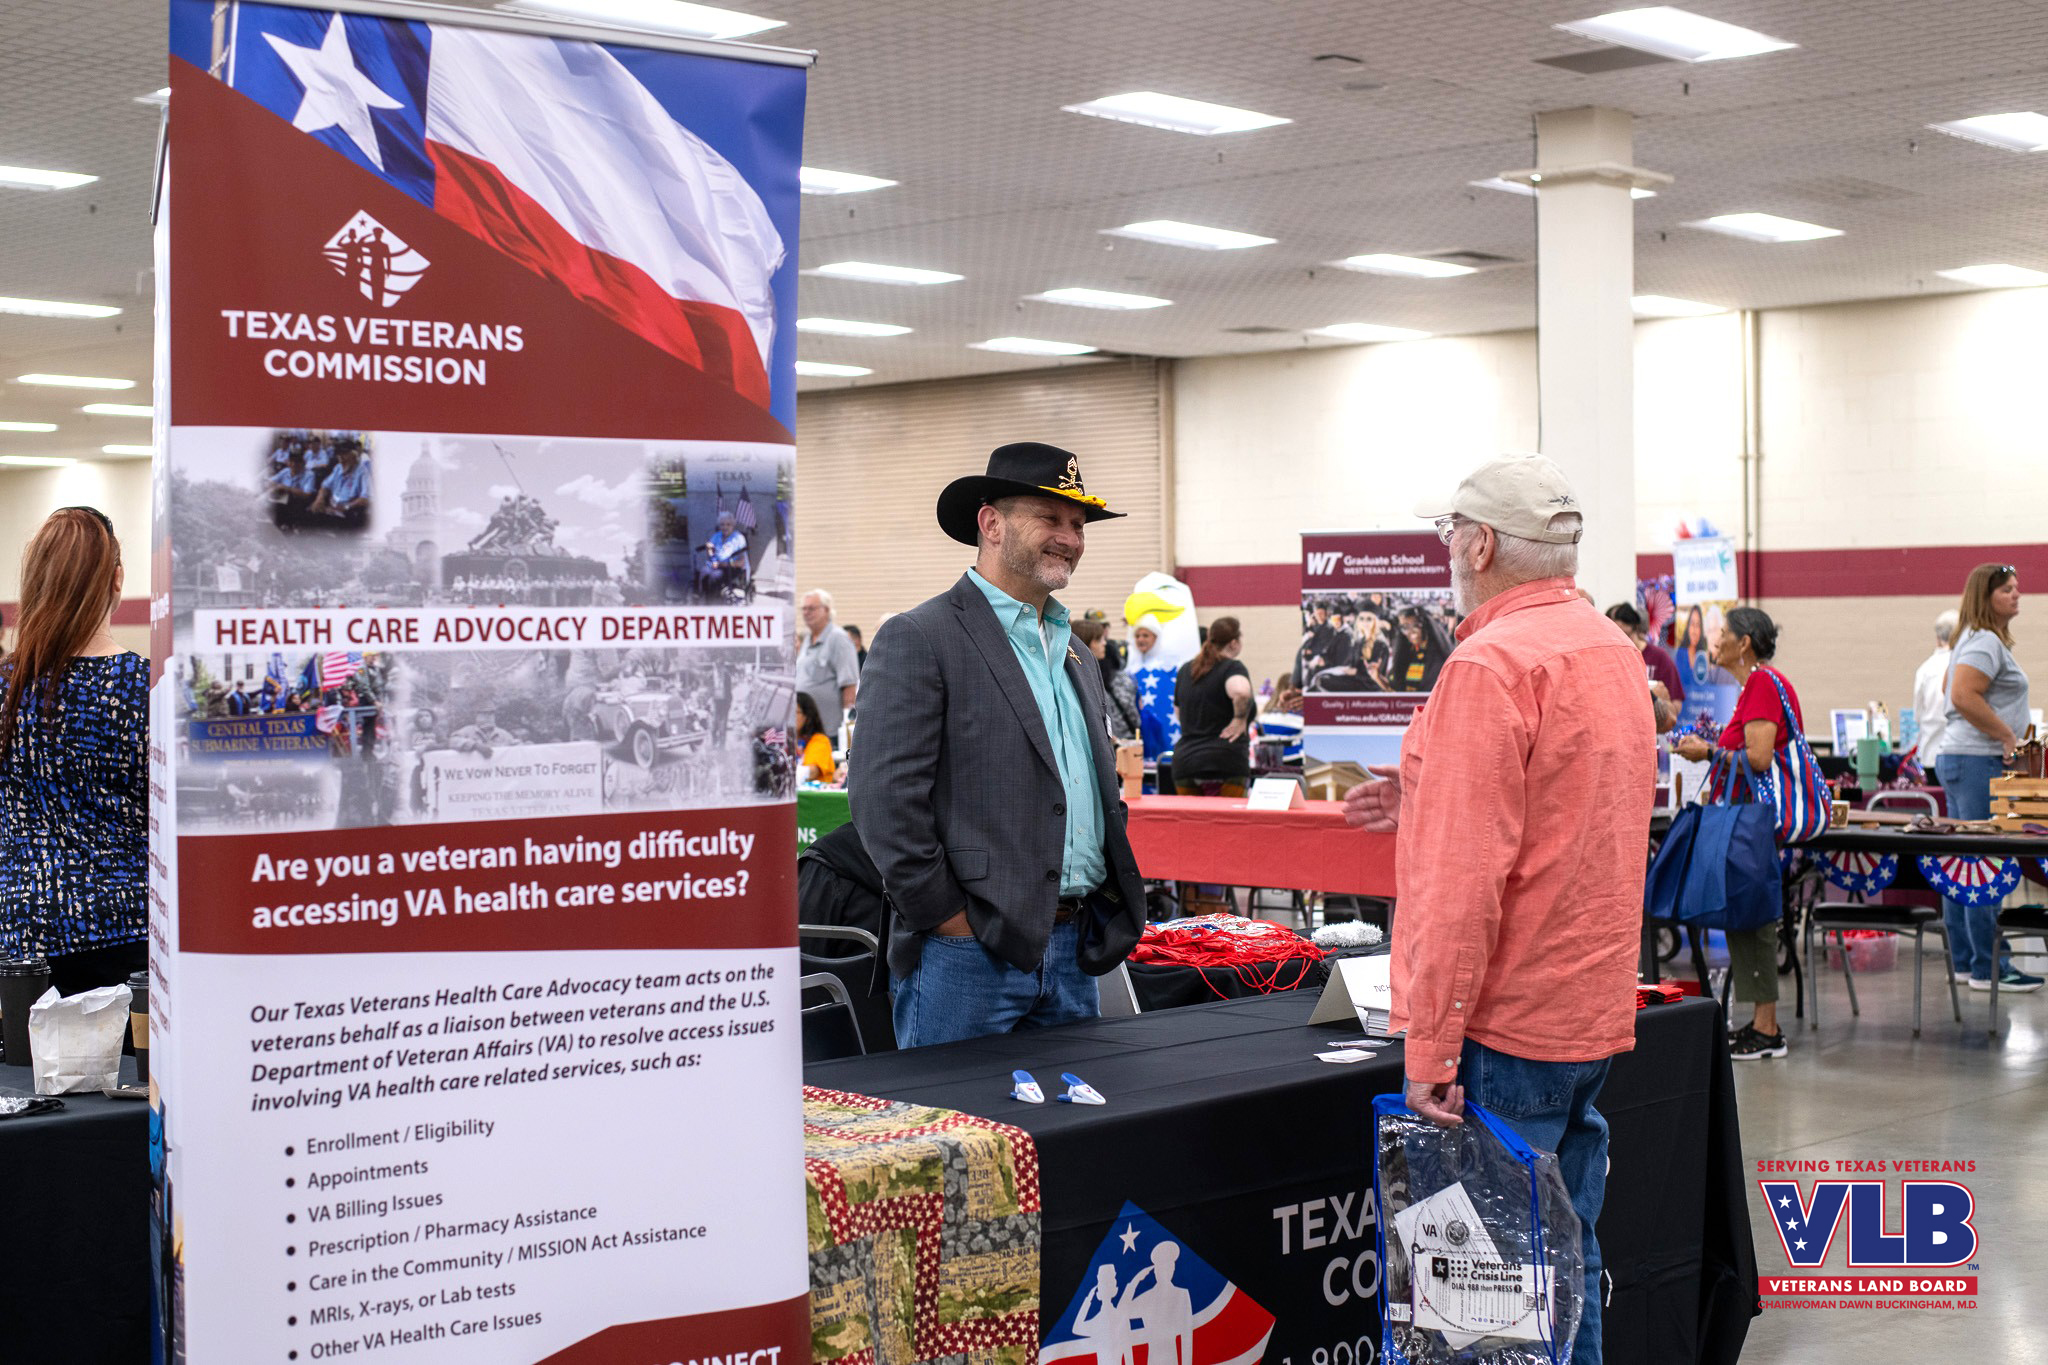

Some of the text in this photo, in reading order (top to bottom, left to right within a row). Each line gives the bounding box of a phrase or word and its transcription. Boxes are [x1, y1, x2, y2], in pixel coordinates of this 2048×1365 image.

[220, 309, 524, 352] TEXAS VETERANS
[263, 348, 486, 386] COMMISSION
[715, 470, 752, 482] TEXAS
[1307, 552, 1424, 575] WT Graduate School
[216, 615, 775, 646] HEALTH CARE ADVOCACY DEPARTMENT
[208, 719, 305, 737] CENTRAL TEXAS
[263, 735, 326, 750] VETERANS
[444, 763, 597, 780] WE VOW NEVER TO FORGET
[251, 828, 755, 887] Are you a veteran having difficulty
[251, 869, 750, 929] accessing VA health care services?
[250, 963, 775, 1024] Our Texas Veterans Health Care Advocacy team acts on the
[250, 989, 770, 1053] veterans behalf as a liaison between veterans and the U.S.
[250, 1019, 775, 1085] Department of Veteran Affairs (VA) to resolve access issues
[251, 1051, 702, 1112] involving VA health care related services, such as:
[306, 1118, 495, 1155] Enrollment / Eligibility
[307, 1159, 429, 1192] Appointments
[307, 1193, 444, 1223] VA Billing Issues
[308, 1206, 598, 1258] Prescription / Pharmacy Assistance
[1422, 1224, 1437, 1237] VA
[308, 1225, 707, 1292] Care in the Community / MISSION Act Assistance
[1471, 1271, 1522, 1282] Crisis Line
[1472, 1259, 1522, 1271] Veterans
[310, 1282, 516, 1326] MRIs, X-rays, or Lab tests
[1452, 1282, 1465, 1290] DIAL
[1467, 1283, 1479, 1292] 988
[1481, 1284, 1492, 1292] then
[1494, 1284, 1512, 1293] PRESS
[310, 1312, 542, 1360] Other VA Health Care Issues
